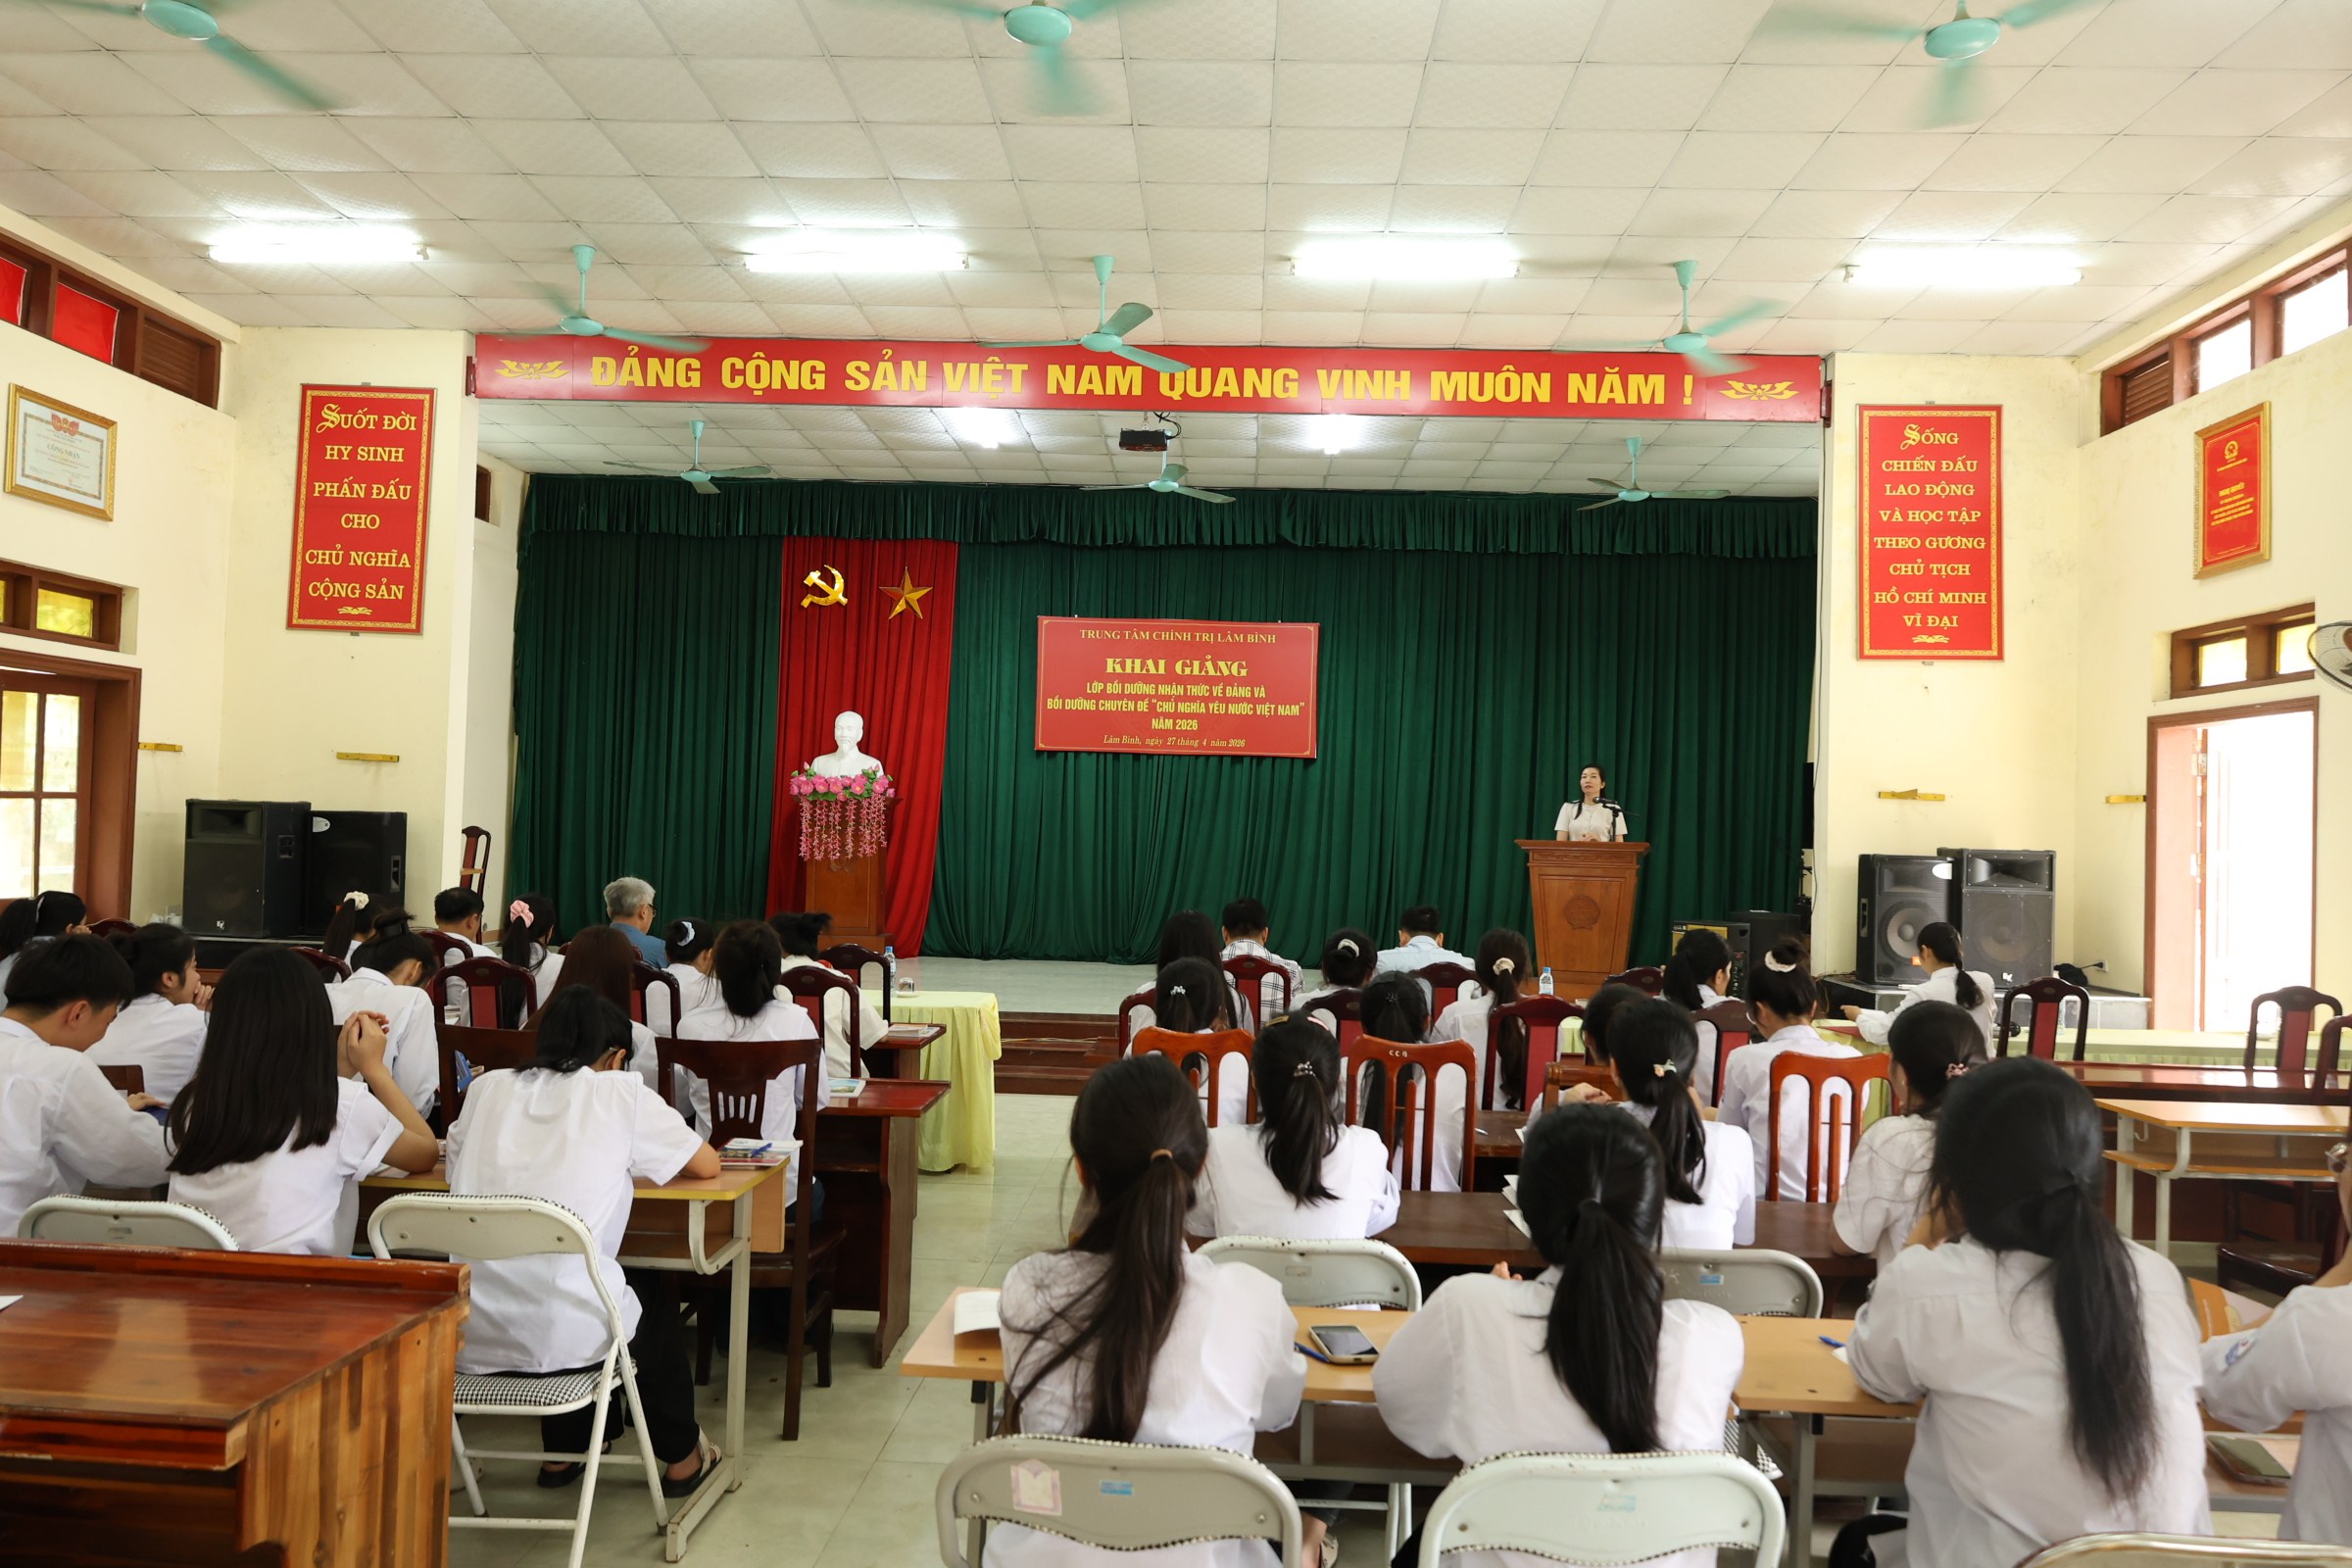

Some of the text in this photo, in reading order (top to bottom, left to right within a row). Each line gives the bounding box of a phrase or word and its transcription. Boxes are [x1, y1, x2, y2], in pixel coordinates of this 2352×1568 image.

[590, 346, 1693, 406] ĐẢNG CỘNG SẢN VIỆT NAM QUANG VINH MUÔN NĂM !
[316, 403, 417, 433] SUỐT ĐỜI
[1900, 423, 1960, 450] SỐNG
[325, 445, 404, 463] HY SINH
[1881, 455, 1978, 472] CHIẾN ĐẤU
[313, 475, 412, 500] PHẤN ĐẤU
[1885, 480, 1976, 499] LAO ĐỘNG
[340, 513, 380, 529] CHO
[1879, 506, 1982, 526] VÀ HỌC TẬP
[1874, 534, 1986, 550] THEO GƯƠNG
[305, 543, 412, 567] CHỦ NGHĨA
[1889, 559, 1972, 579] CHỦ TỊCH
[308, 577, 405, 601] CỘNG SẢN
[1874, 585, 1987, 605] HỒ CHÍ MINH
[1903, 612, 1959, 630] VĨ ĐẠI
[1080, 628, 1276, 644] TRUNG TÂM CHÍNH TRỊ LÂM BÌNH
[1105, 655, 1249, 676] KHAI GIẢNG
[1087, 680, 1104, 694] LỚP
[1124, 681, 1155, 695] DƯỠNG
[1158, 682, 1184, 697] NHẬN
[1187, 683, 1210, 697] THỨC
[1226, 683, 1251, 698] ĐẢNG
[1254, 685, 1266, 698] VÀ
[1065, 697, 1096, 710] DƯỠNG
[1099, 698, 1135, 711] CHUYÊN
[1178, 700, 1206, 713] NGHĨA
[1208, 701, 1226, 714] YÊU
[1228, 702, 1253, 715] NƯỚC
[1256, 702, 1275, 717] VIỆT
[1152, 716, 1199, 730] NĂM 2026
[1103, 735, 1120, 744] Lâm
[1122, 736, 1142, 746] Bình,
[1146, 737, 1163, 746] ngày
[1177, 737, 1200, 748] tháng
[1210, 738, 1227, 747] năm
